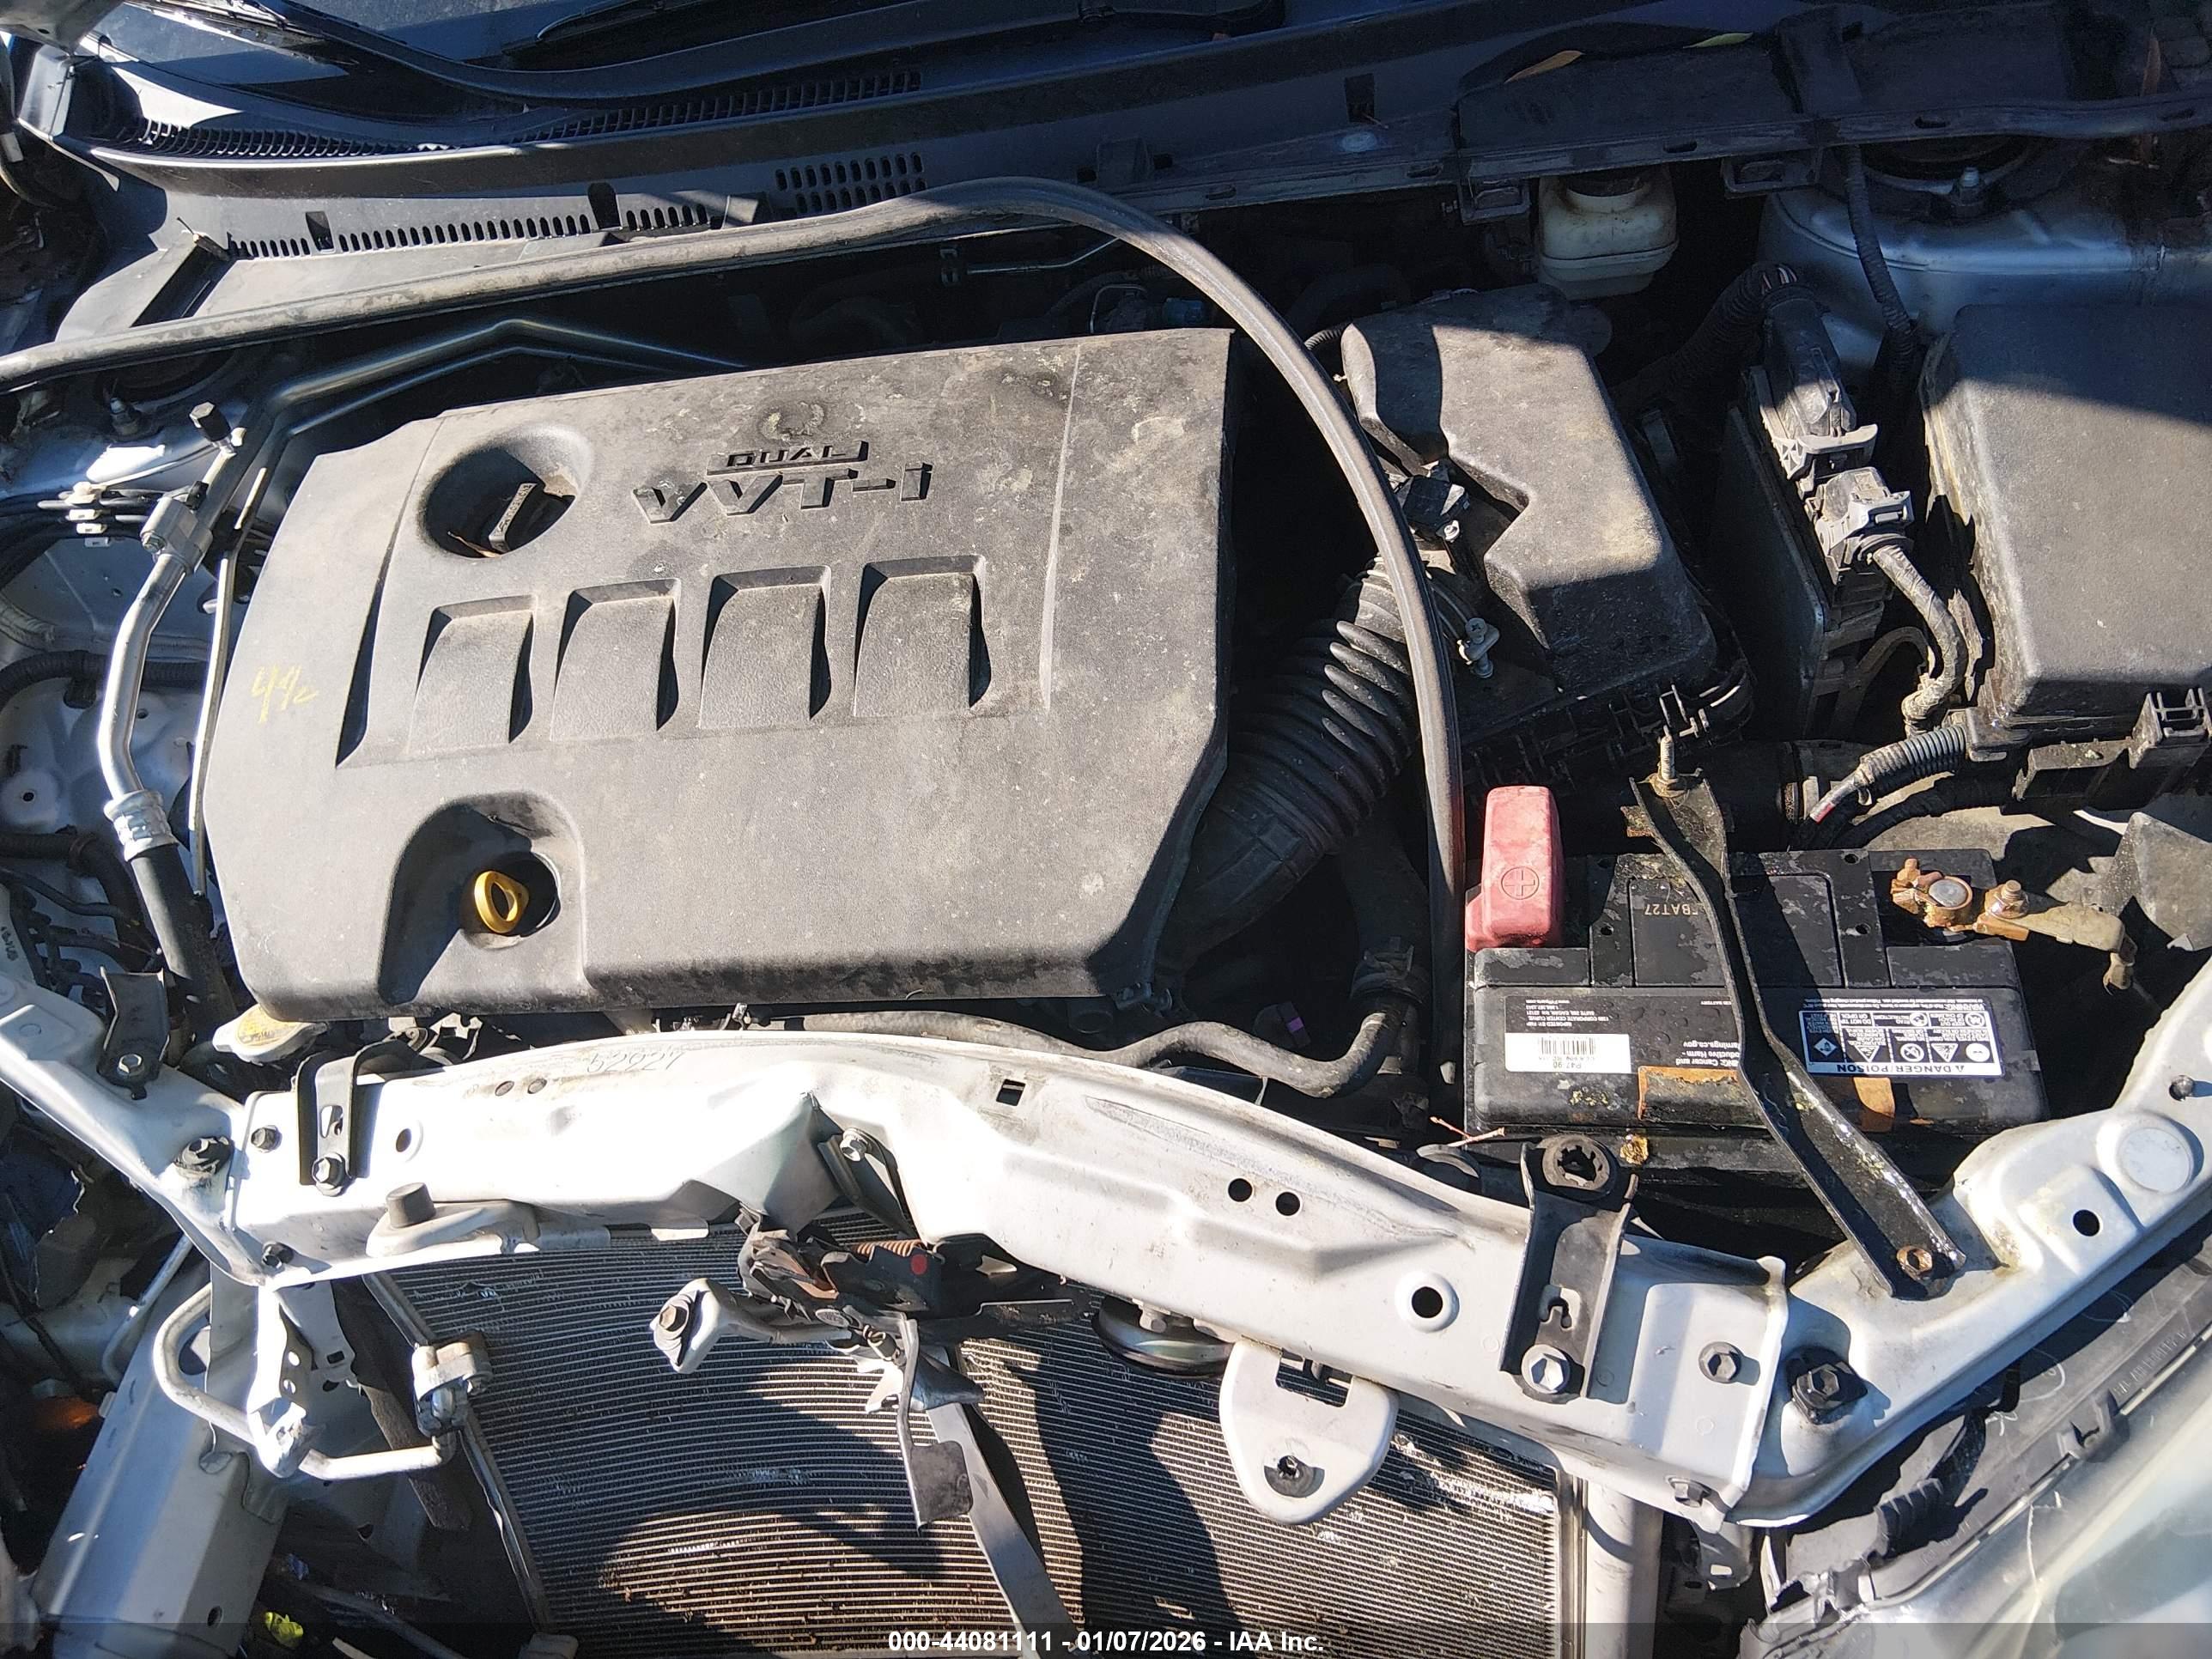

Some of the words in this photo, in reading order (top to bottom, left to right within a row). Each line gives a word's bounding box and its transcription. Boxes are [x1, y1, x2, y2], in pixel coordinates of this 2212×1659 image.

[726, 445, 848, 468] DUAL
[1686, 1050, 1707, 1059] Harm
[1692, 1058, 1718, 1066] Cancer
